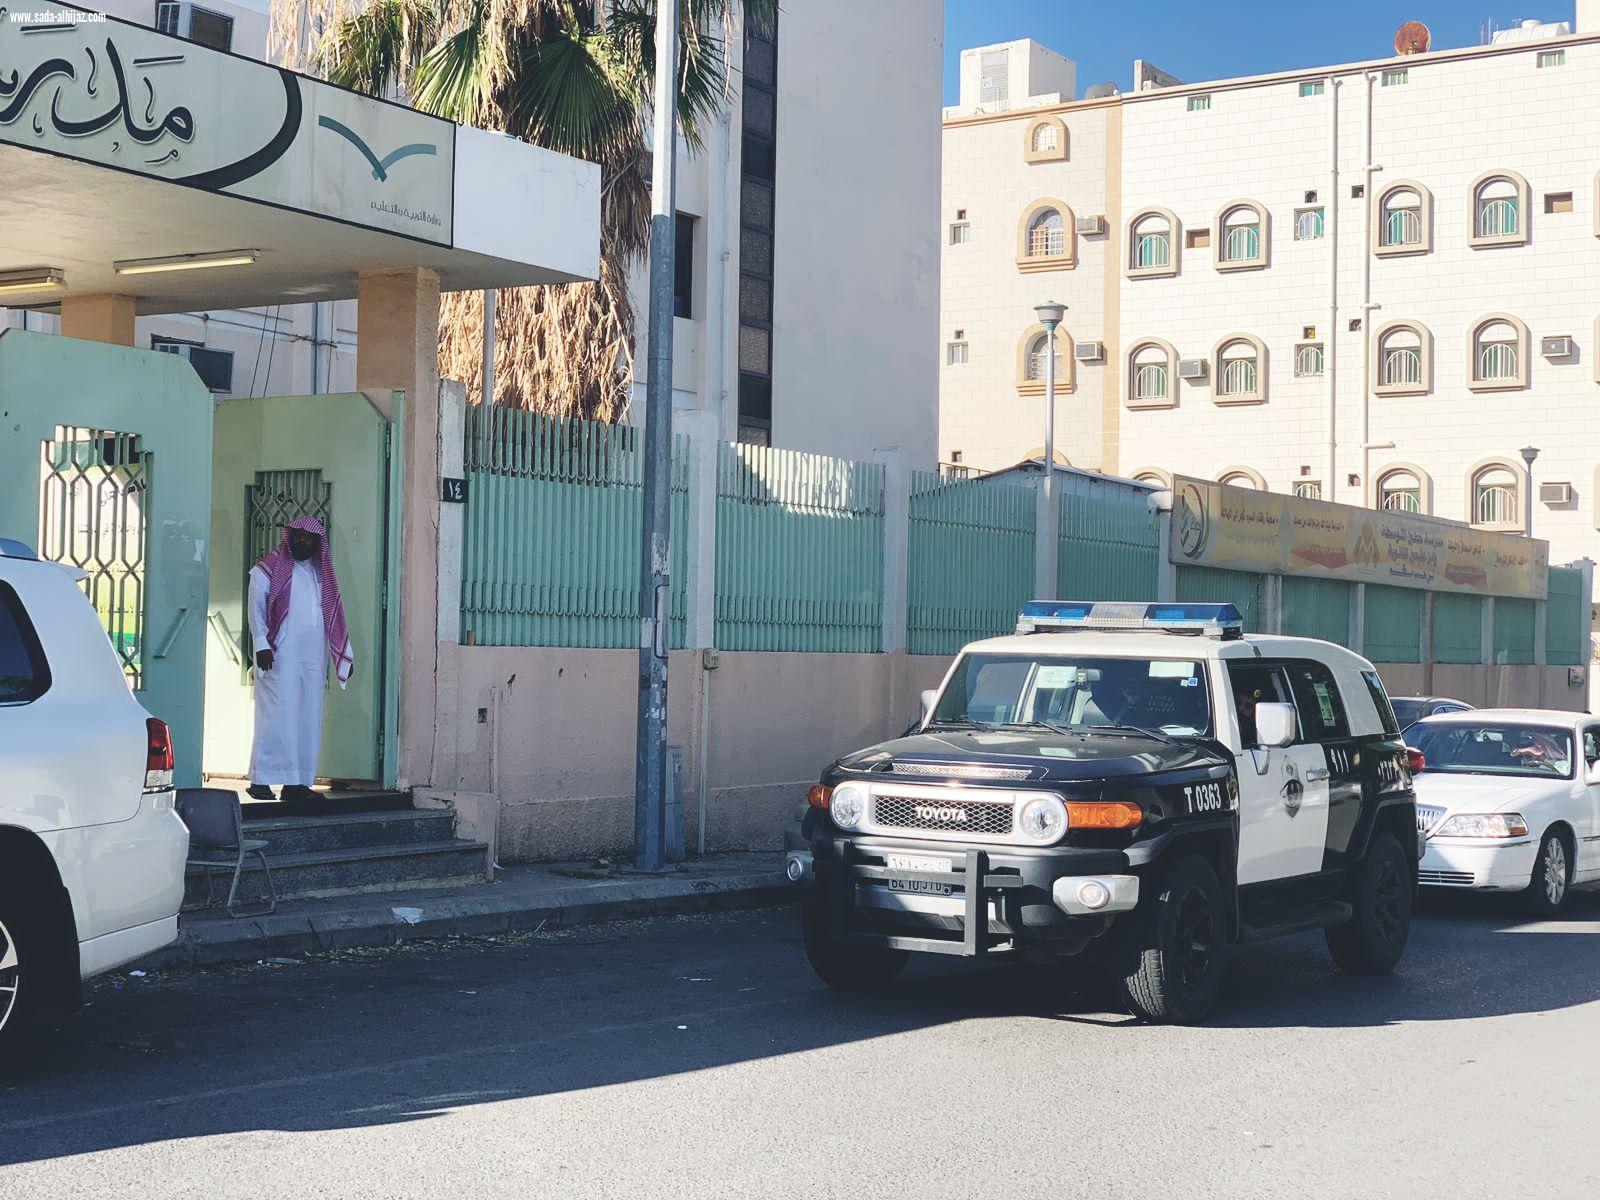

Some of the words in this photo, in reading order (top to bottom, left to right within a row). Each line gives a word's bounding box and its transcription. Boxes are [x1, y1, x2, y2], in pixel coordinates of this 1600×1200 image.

[1183, 786, 1192, 813] T
[1195, 783, 1222, 812] 0363
[915, 806, 967, 821] TOYOTA
